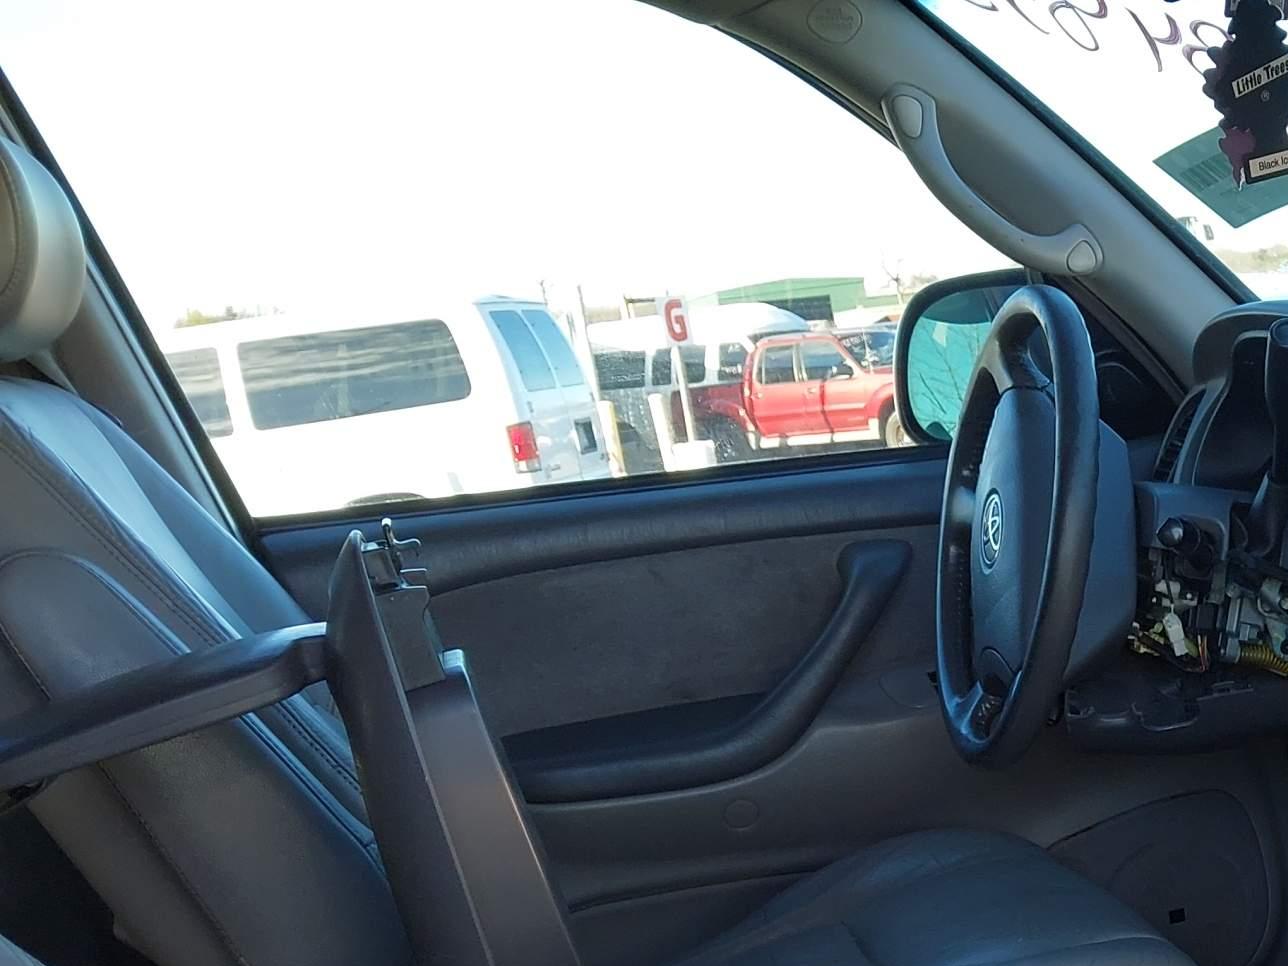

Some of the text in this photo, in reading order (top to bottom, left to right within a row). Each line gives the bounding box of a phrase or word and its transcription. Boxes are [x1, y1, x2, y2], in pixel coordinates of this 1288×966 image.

[1236, 71, 1262, 95] Little
[1258, 158, 1281, 171] Black
[664, 298, 688, 342] G
